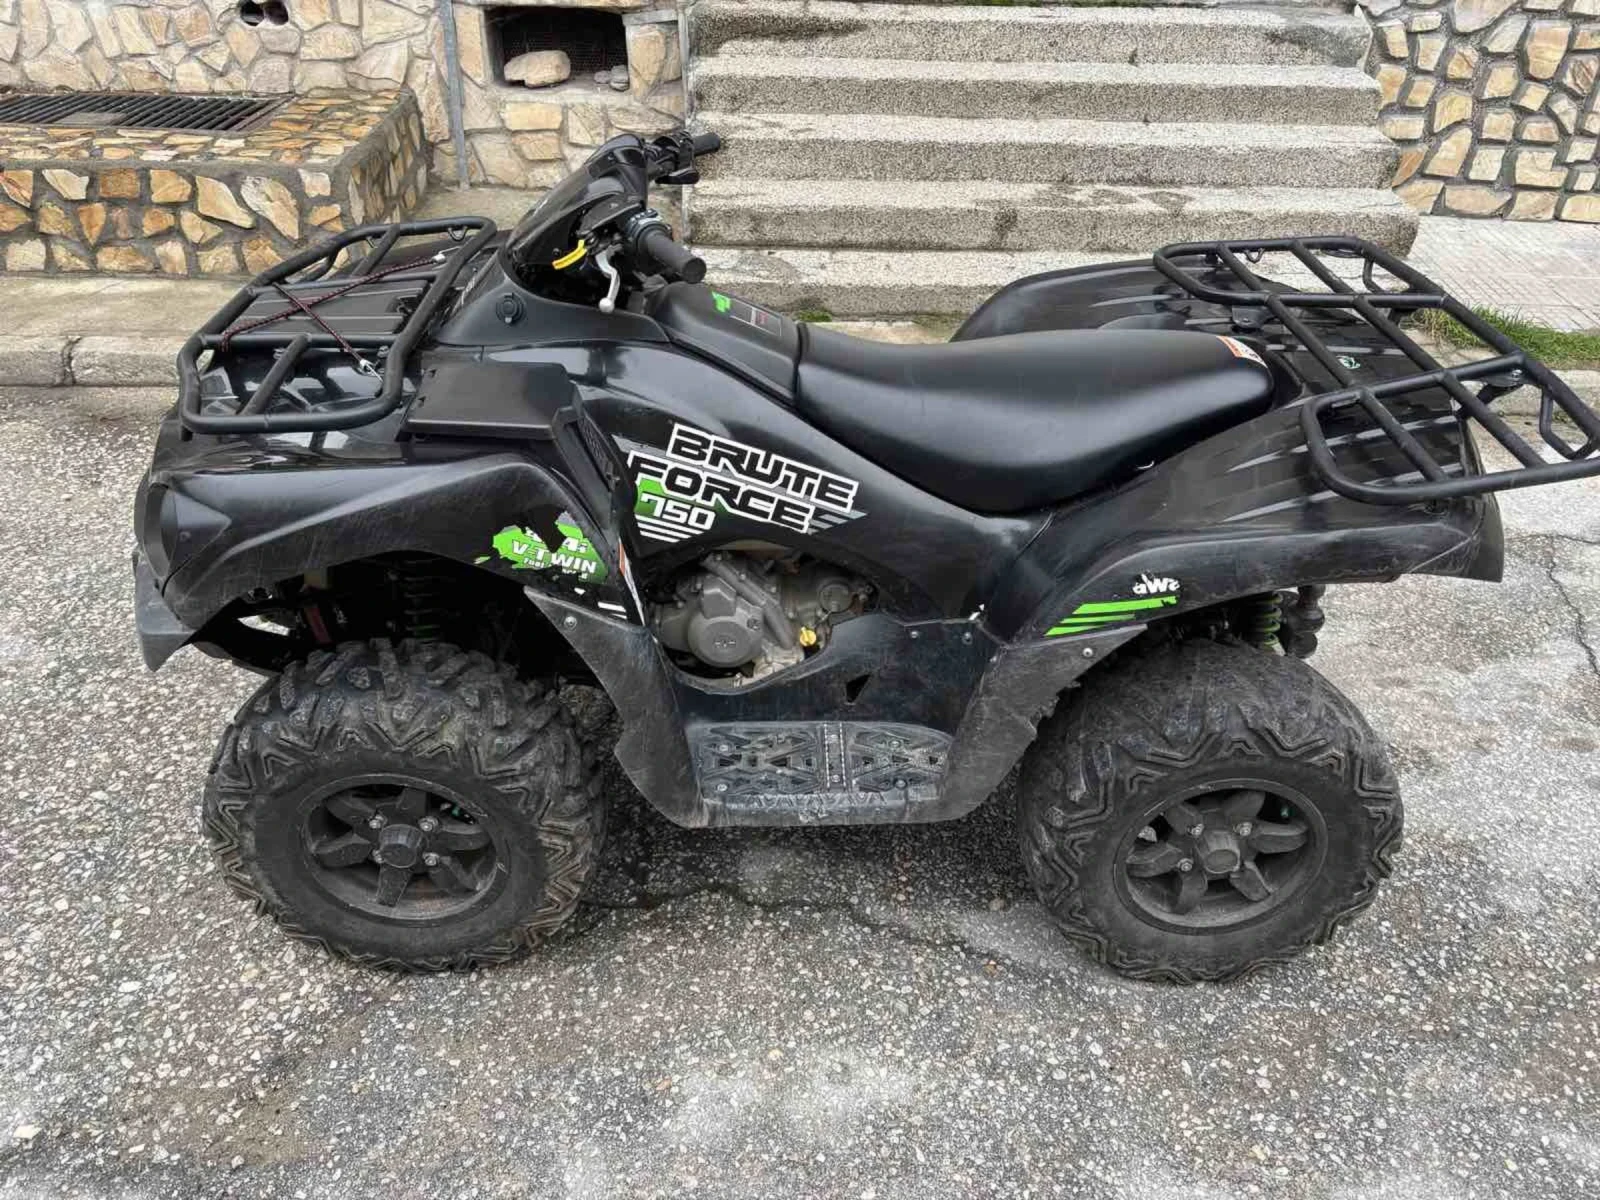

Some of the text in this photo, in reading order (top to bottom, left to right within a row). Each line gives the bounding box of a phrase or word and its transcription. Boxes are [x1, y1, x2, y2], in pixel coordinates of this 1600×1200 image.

[627, 450, 815, 534] FORCE
[666, 423, 859, 513] BRUTE
[641, 492, 716, 530] 750
